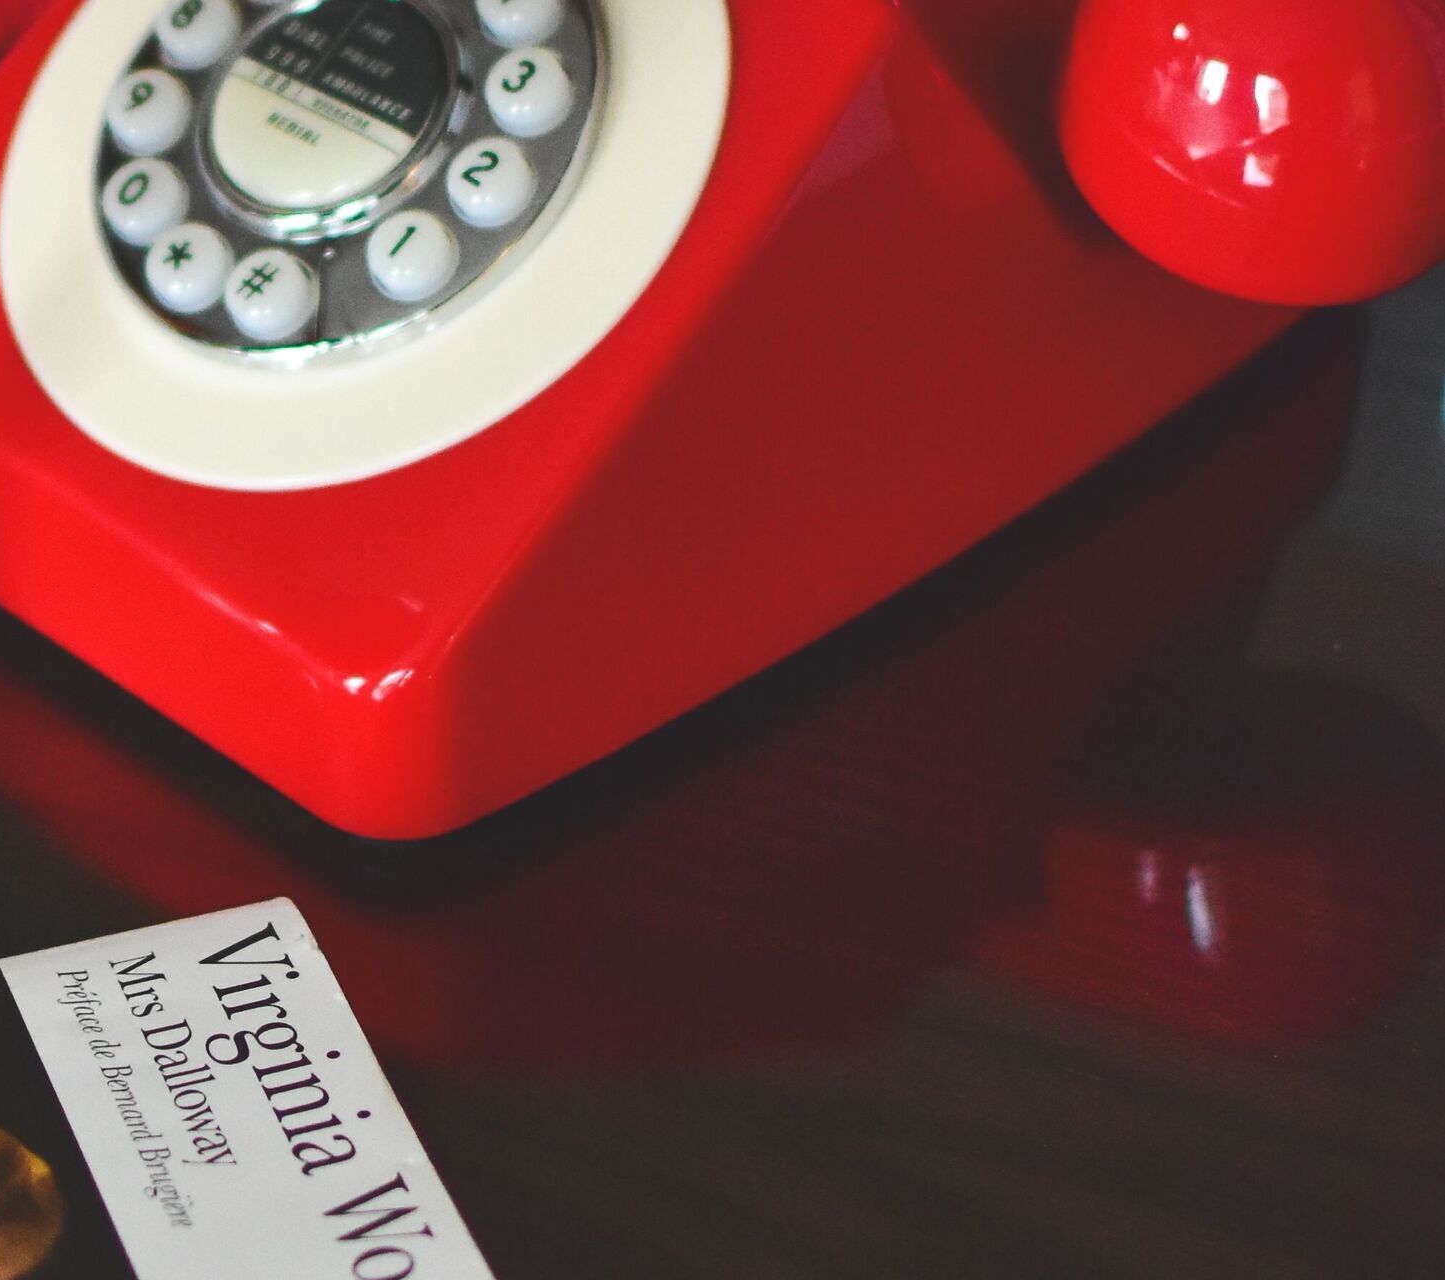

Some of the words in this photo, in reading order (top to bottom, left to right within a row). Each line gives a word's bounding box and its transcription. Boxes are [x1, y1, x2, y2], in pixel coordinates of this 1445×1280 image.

[125, 81, 155, 111] 9
[501, 60, 536, 95] 3
[461, 150, 500, 187] 2
[389, 224, 417, 257] 1
[57, 969, 104, 1035] Préface
[88, 1039, 122, 1060] de
[108, 951, 167, 1018] Mrs
[140, 1018, 238, 1166] Dalloway
[197, 921, 372, 1177] Virginia
[100, 1064, 164, 1142] Bernard
